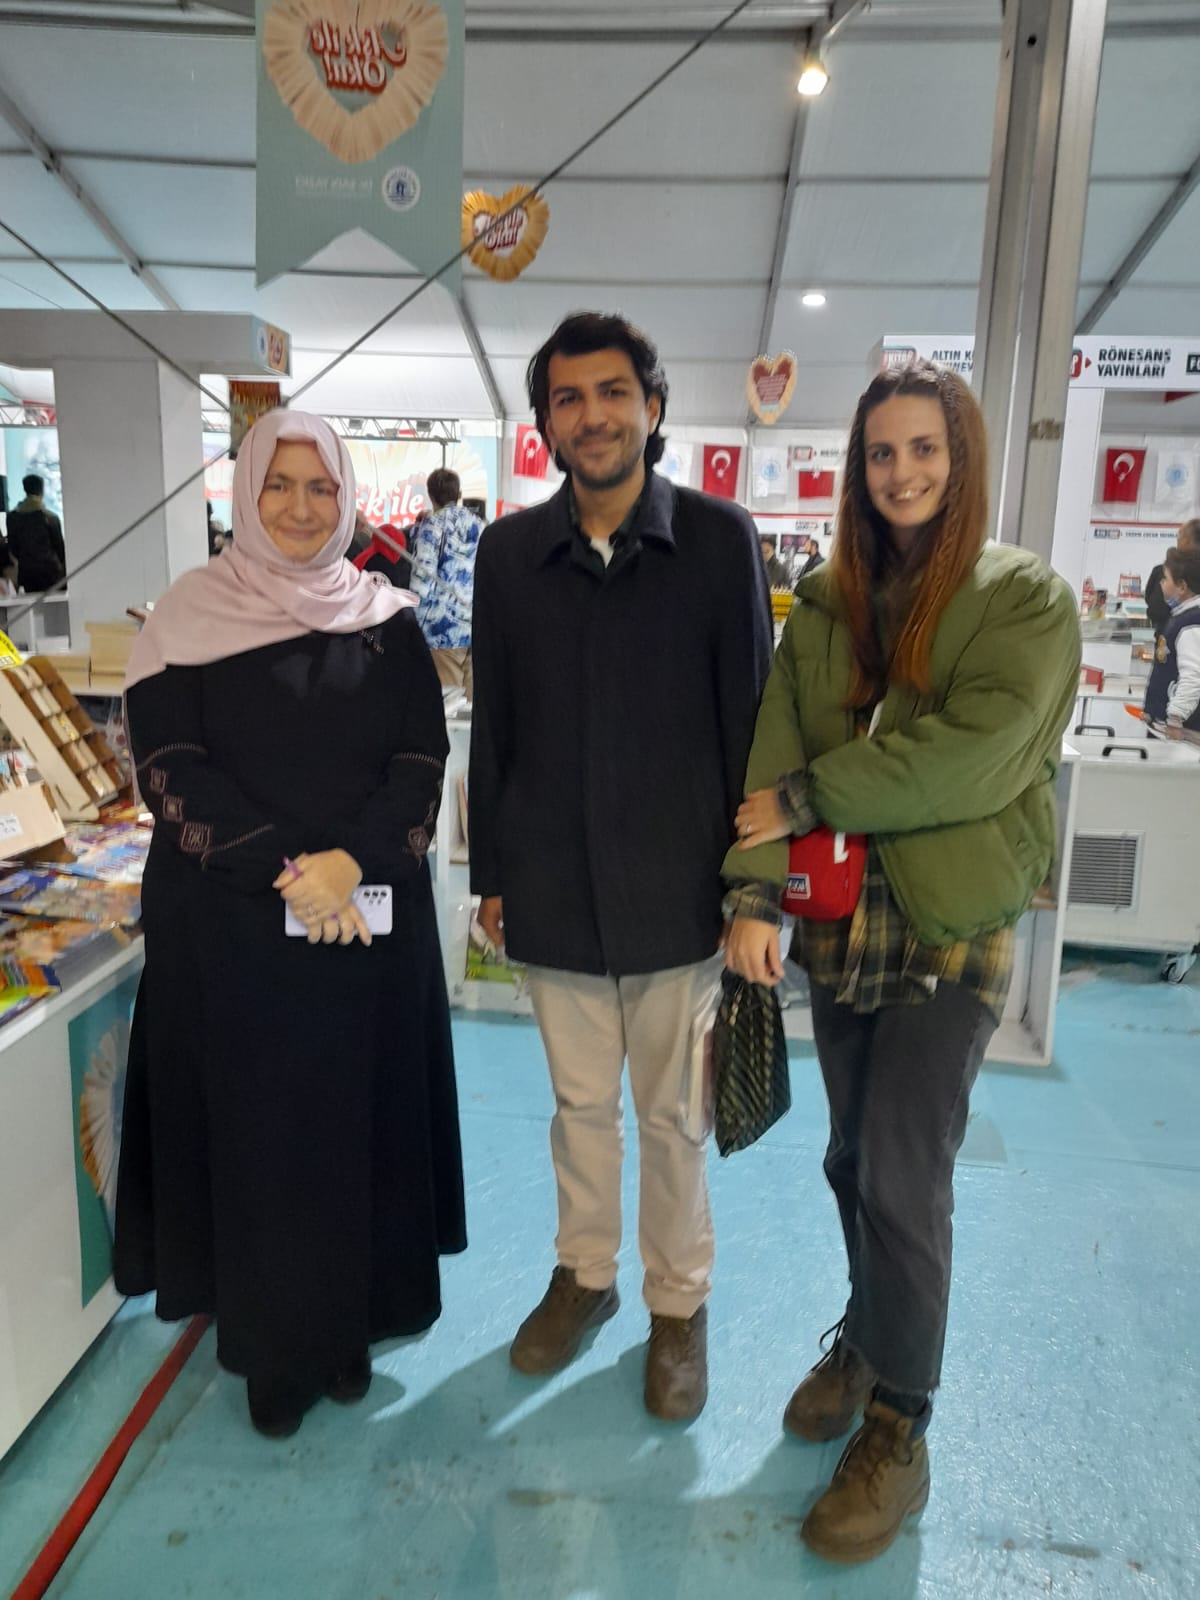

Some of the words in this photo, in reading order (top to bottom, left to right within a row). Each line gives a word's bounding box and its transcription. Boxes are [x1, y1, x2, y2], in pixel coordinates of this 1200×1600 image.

[932, 349, 961, 361] ALTIN
[1098, 345, 1171, 362] RÖNESANS
[1097, 363, 1166, 377] YAYINLARI
[391, 484, 425, 516] ile
